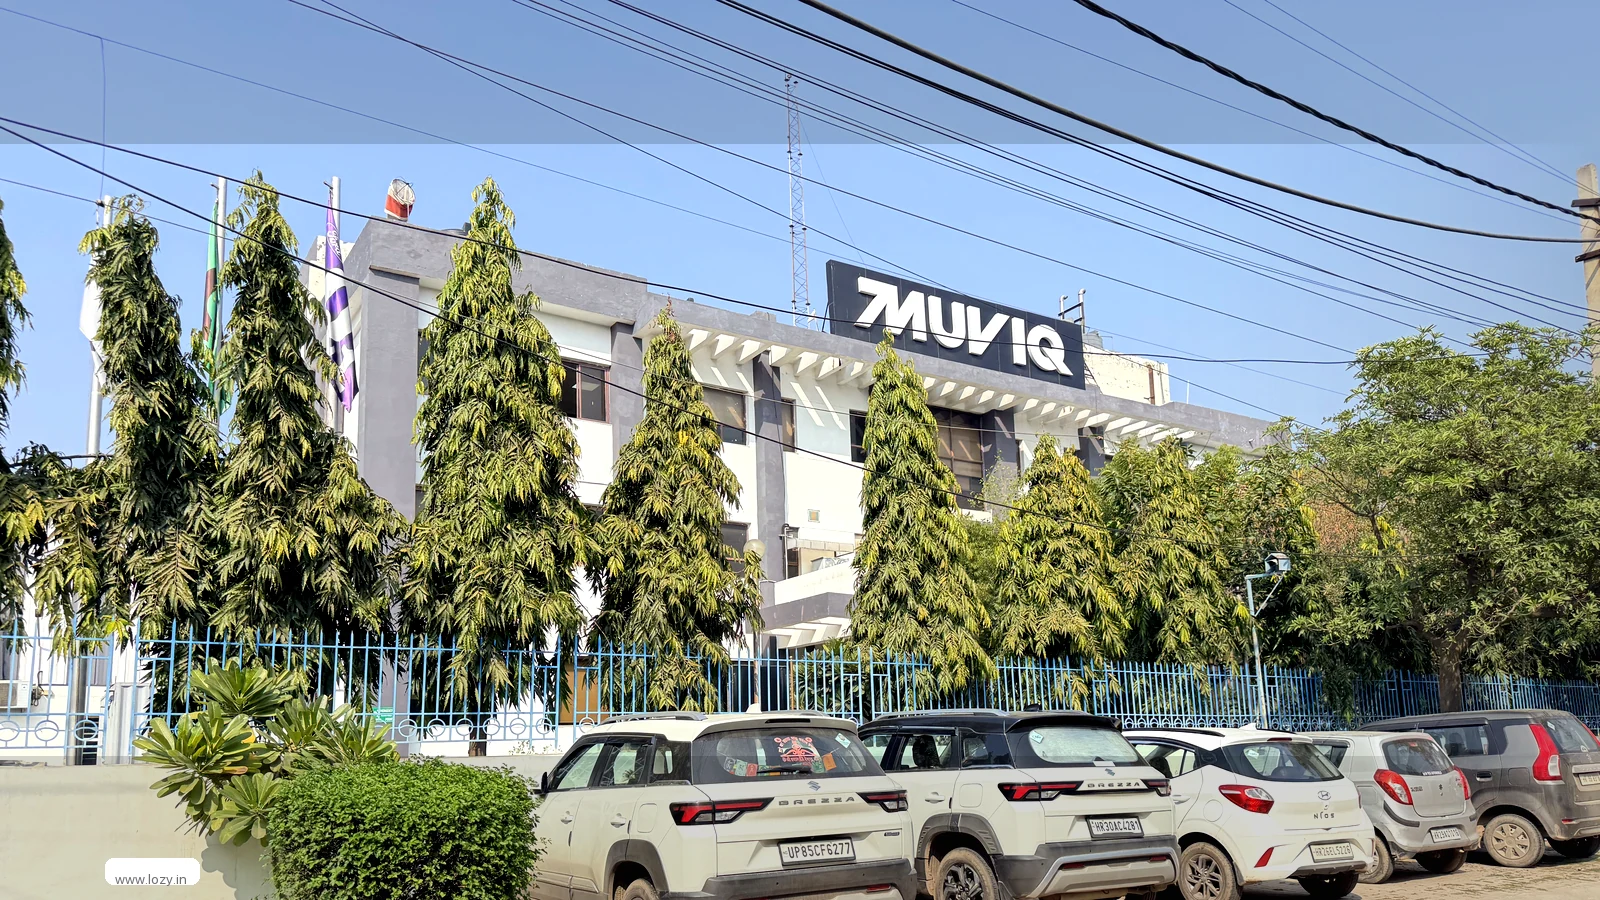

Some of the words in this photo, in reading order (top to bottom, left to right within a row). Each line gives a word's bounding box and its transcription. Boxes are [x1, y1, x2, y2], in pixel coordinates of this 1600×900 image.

[853, 276, 1074, 376] MUVIQ
[778, 796, 856, 806] BREZZA
[1095, 820, 1140, 832] HR30AC4281
[787, 842, 850, 859] UP85CF6277
